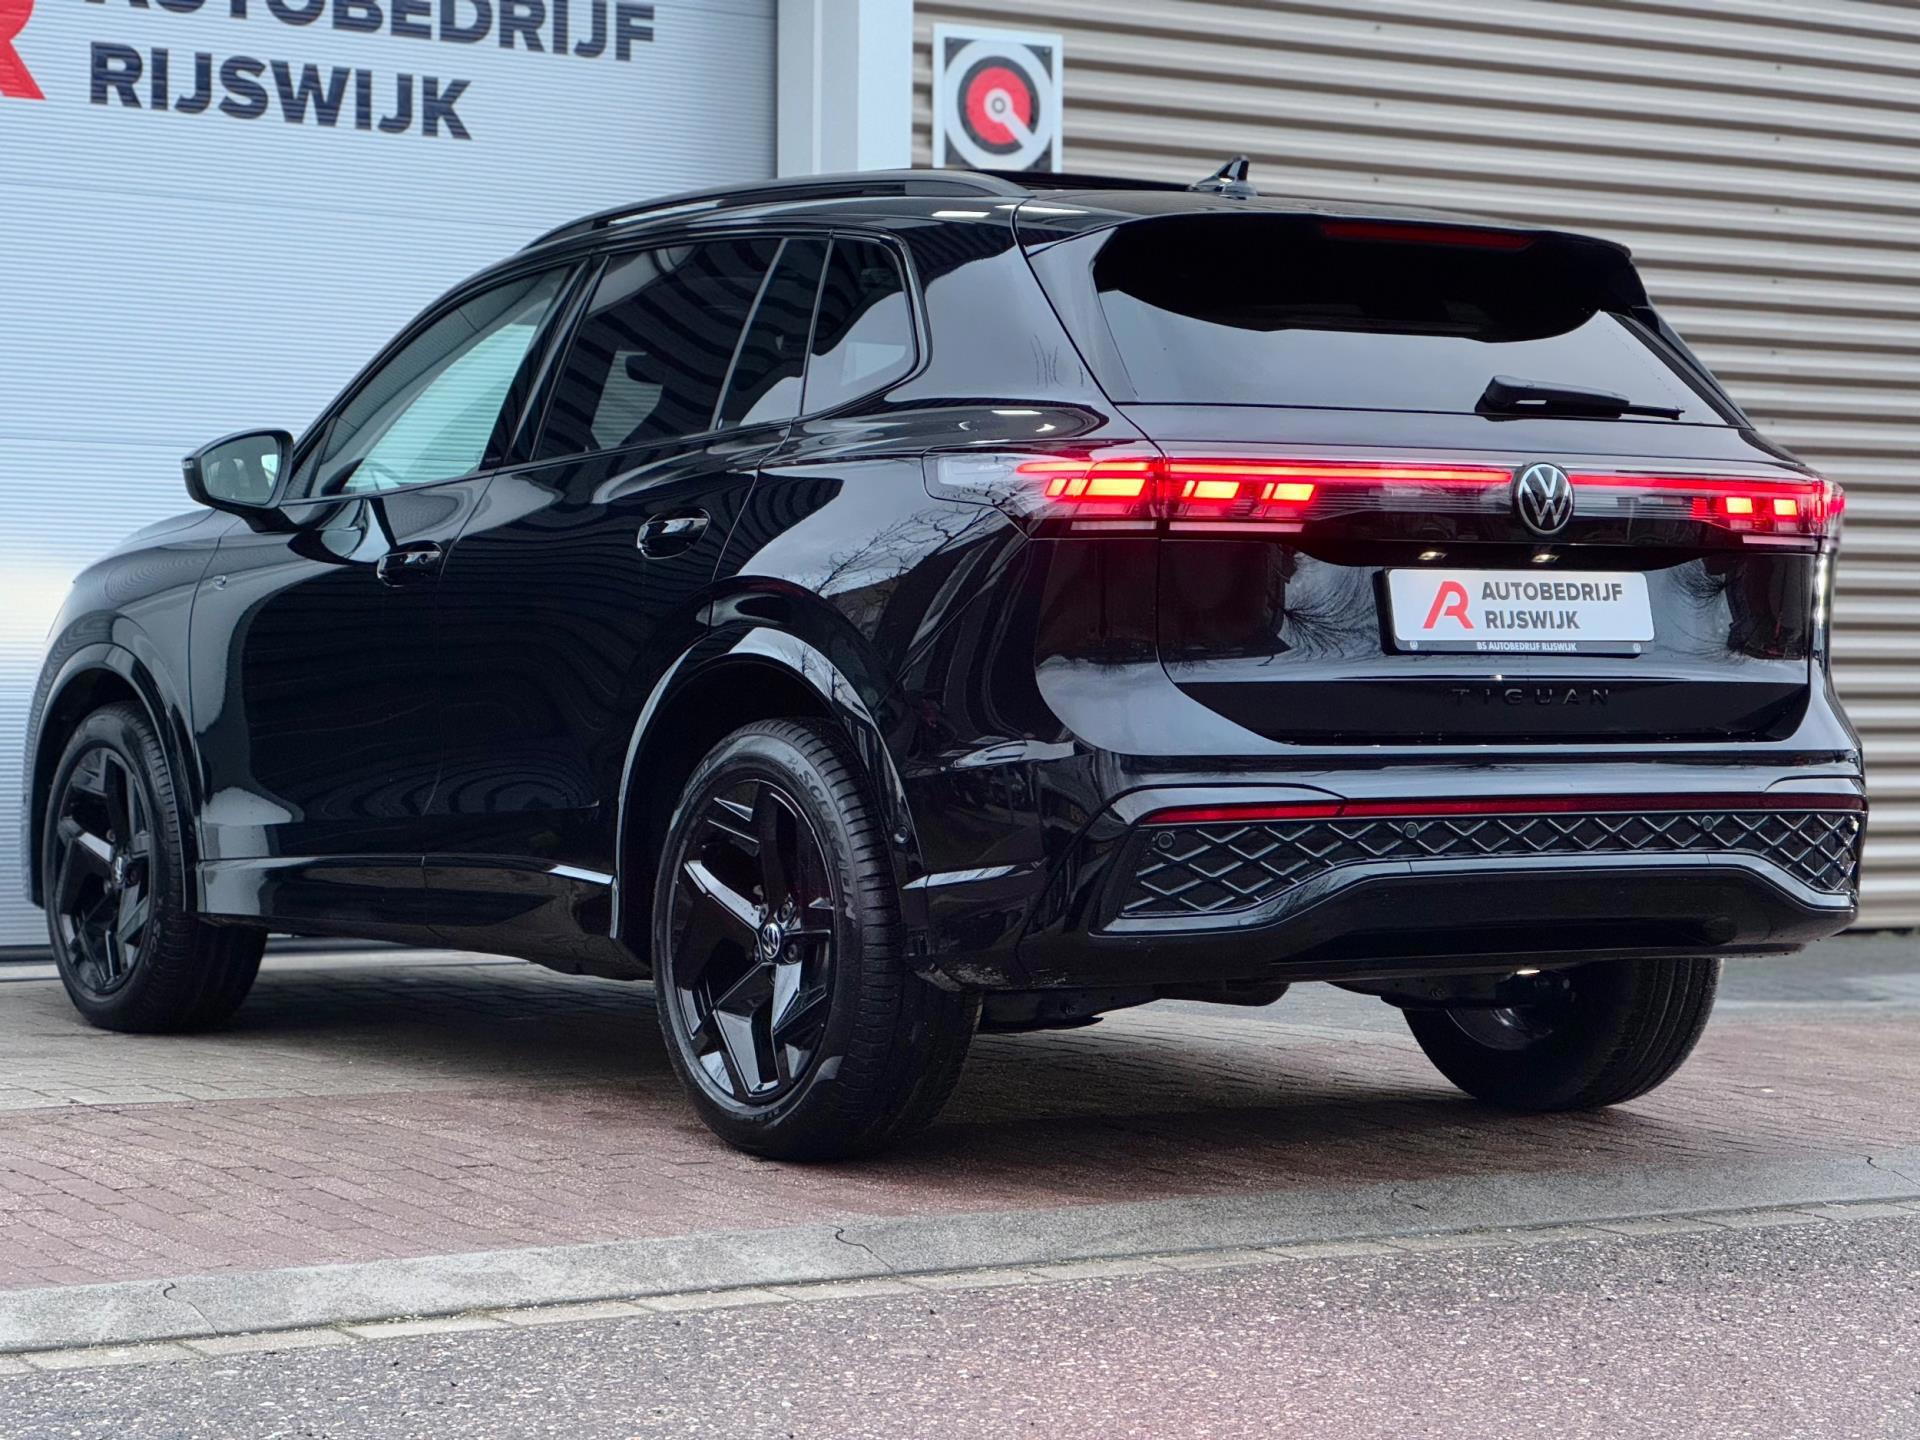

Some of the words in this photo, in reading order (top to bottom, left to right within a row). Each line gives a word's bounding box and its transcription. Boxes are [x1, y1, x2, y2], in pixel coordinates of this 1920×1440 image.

[85, 0, 654, 61] BEDRIJF
[90, 41, 472, 140] RIJSWIJK
[1481, 581, 1623, 602] AUTOBEDRIJF
[1484, 610, 1581, 630] RIJSWIJK
[1488, 641, 1540, 651] AUTOBEDRIJF
[1541, 642, 1577, 652] RIJSWIJK
[1450, 688, 1609, 706] TIGUAN
